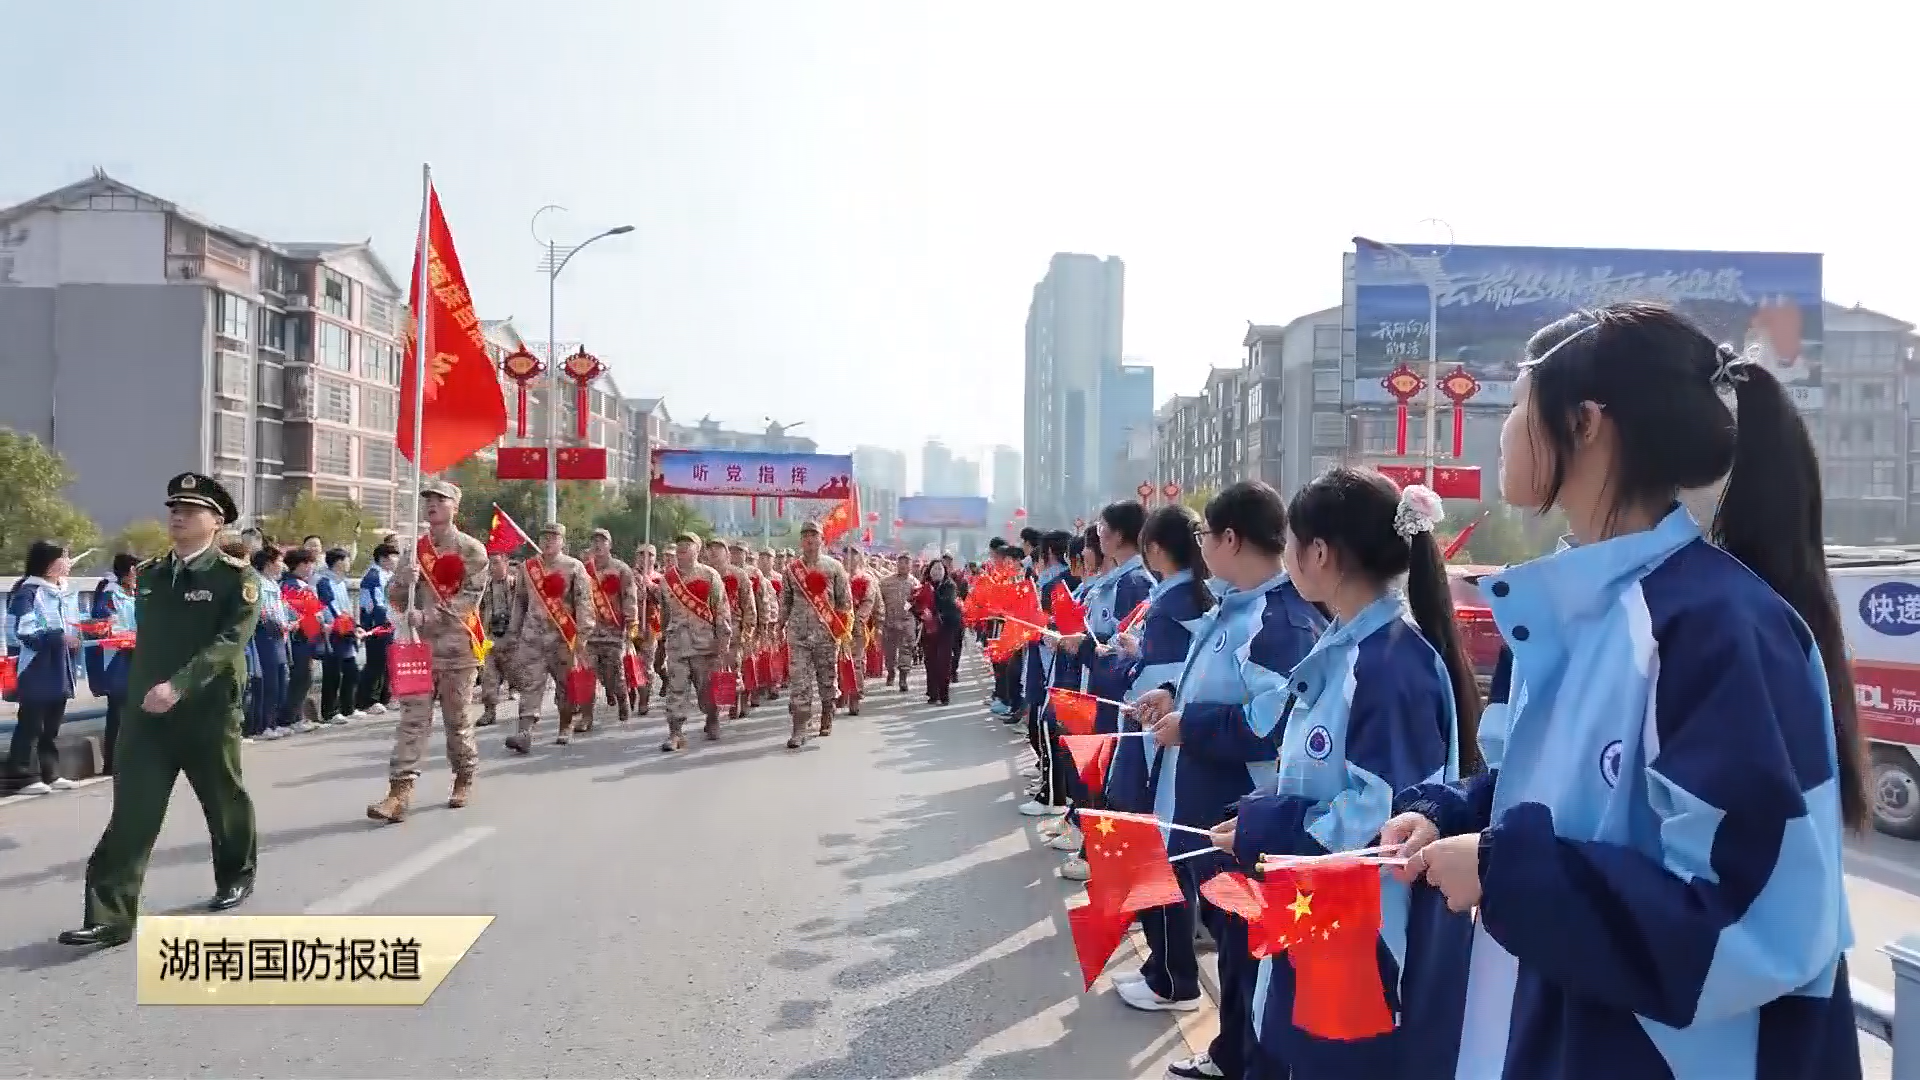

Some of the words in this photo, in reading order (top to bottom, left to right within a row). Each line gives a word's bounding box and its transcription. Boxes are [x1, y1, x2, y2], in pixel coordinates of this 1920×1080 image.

[693, 464, 808, 485] 听党指挥
[1868, 593, 1920, 624] 快递
